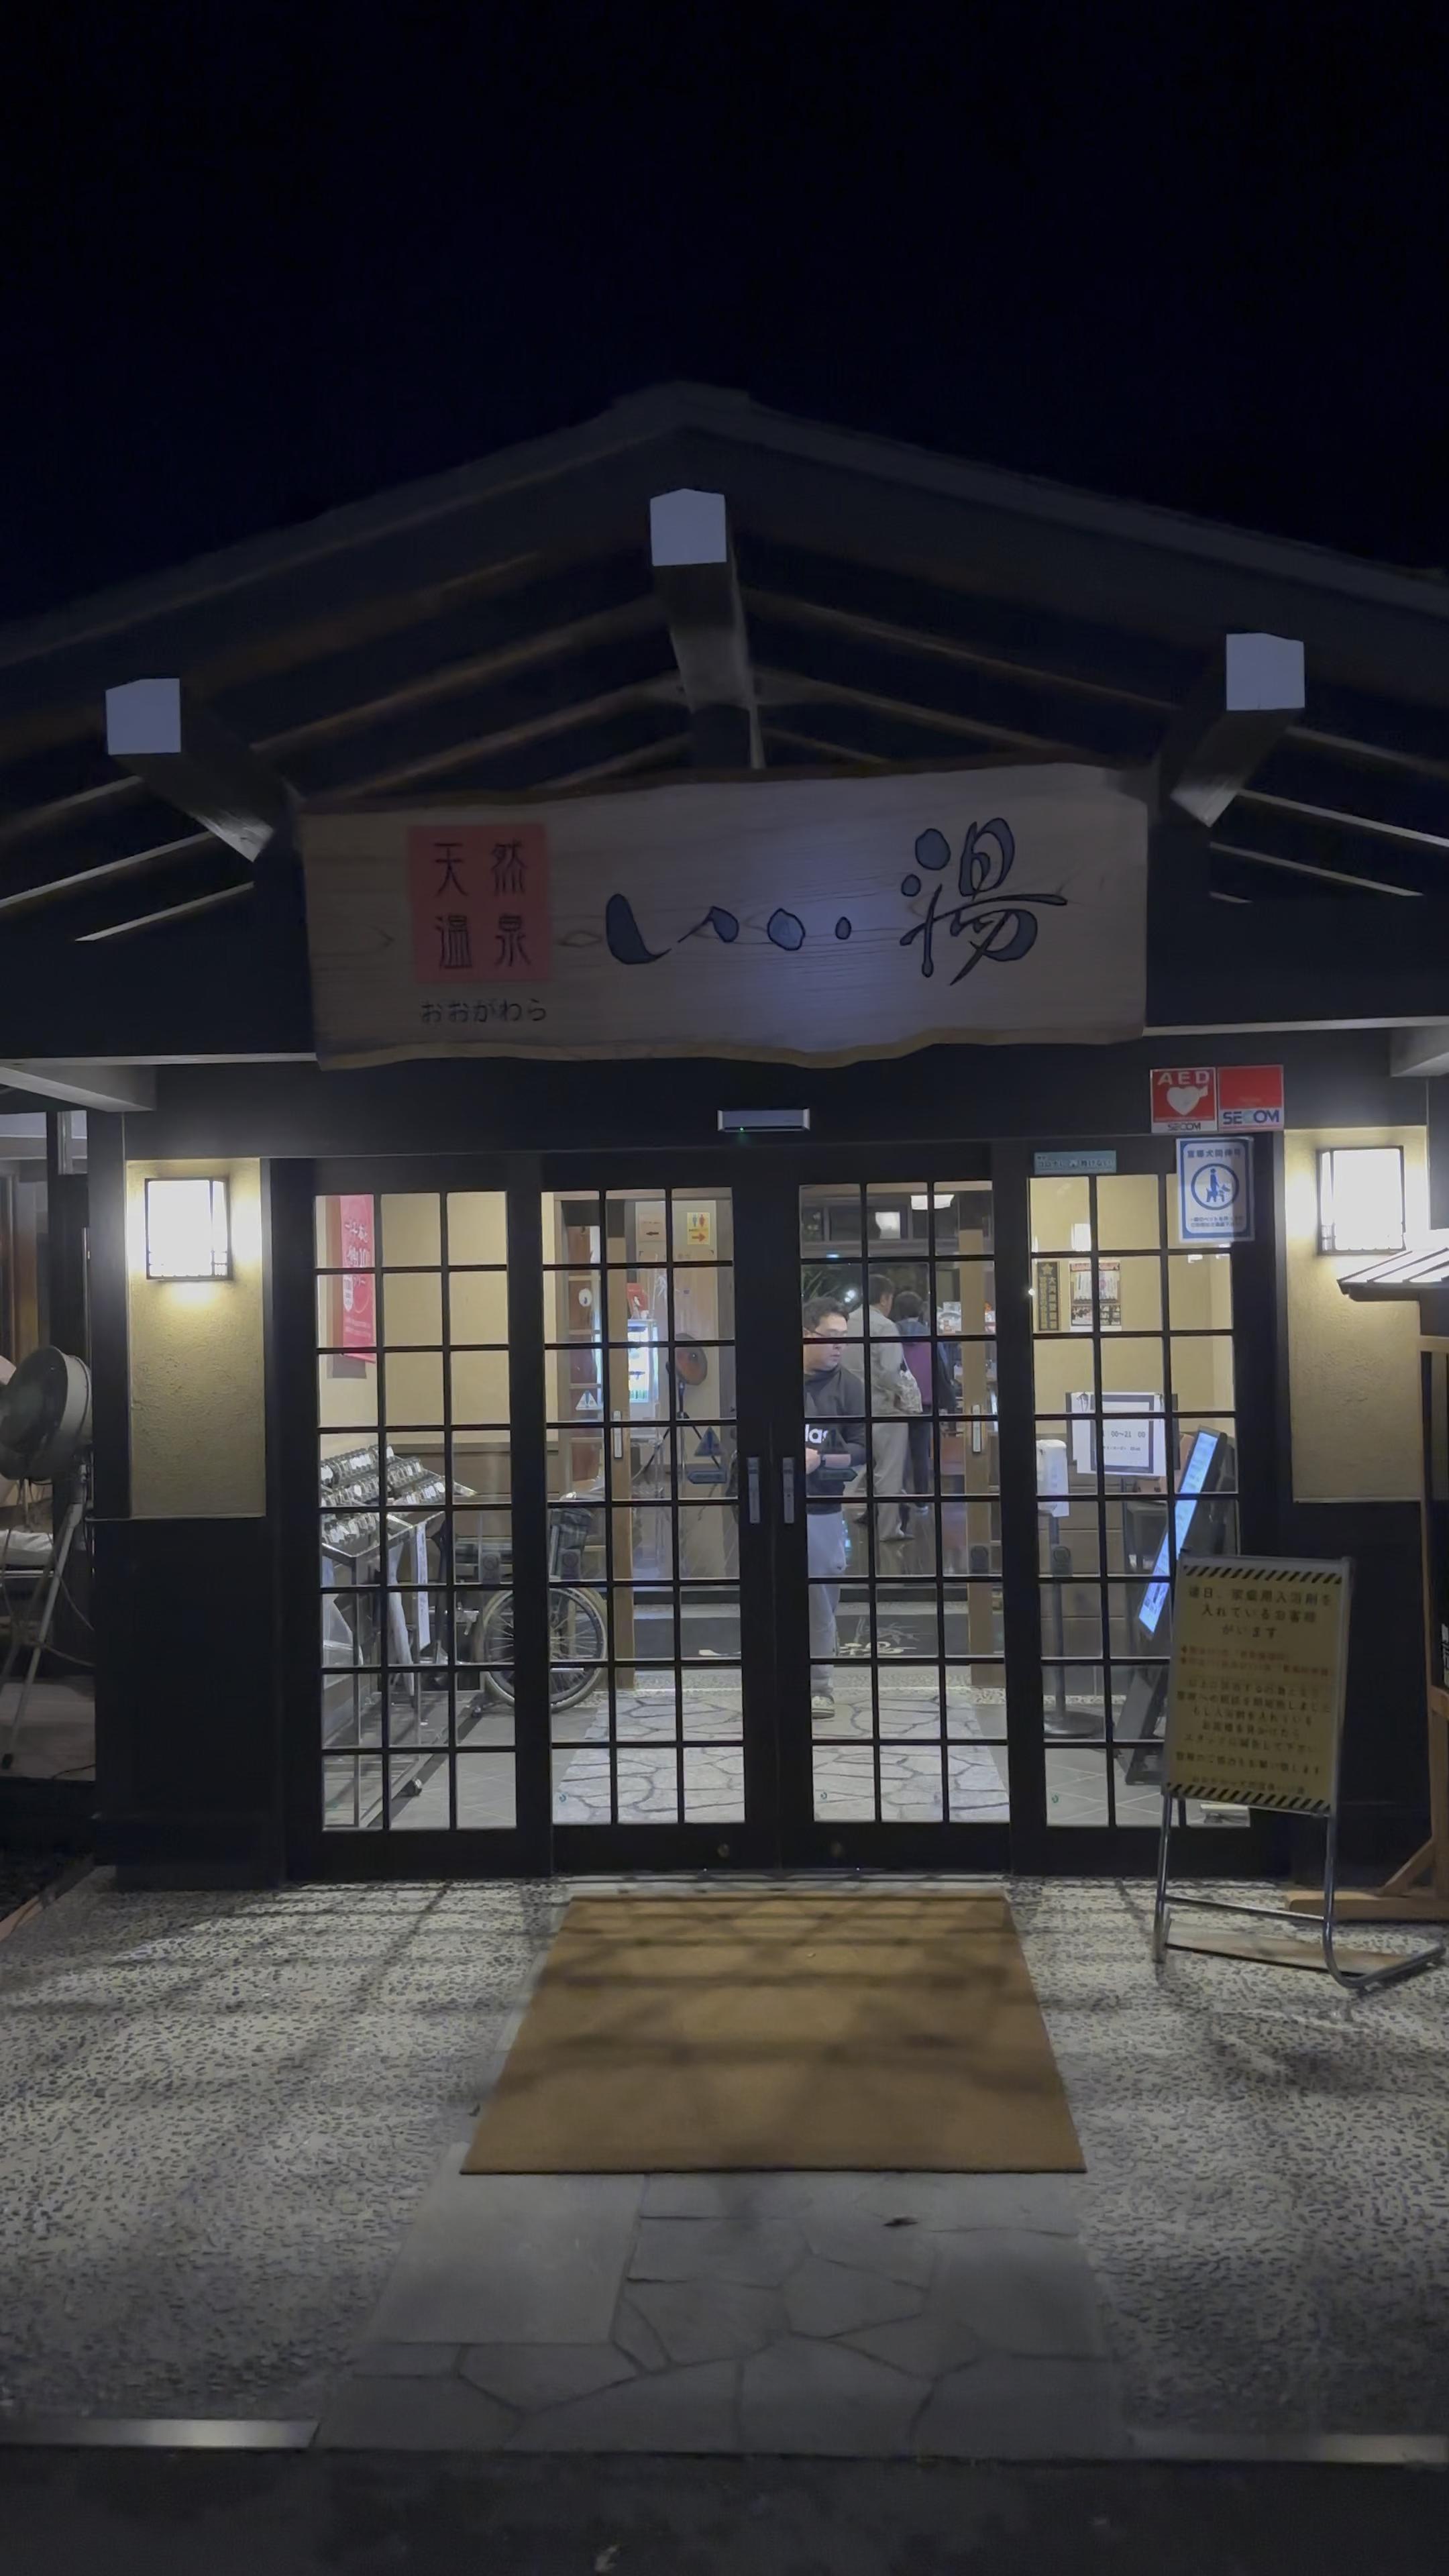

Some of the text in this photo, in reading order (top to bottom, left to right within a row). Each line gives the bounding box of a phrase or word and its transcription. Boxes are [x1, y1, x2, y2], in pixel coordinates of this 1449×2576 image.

[433, 840, 529, 897] 天然
[435, 914, 532, 969] 温泉
[421, 998, 546, 1023] おおがわら
[1157, 1071, 1210, 1085] AED
[1167, 1122, 1201, 1132] SECOM
